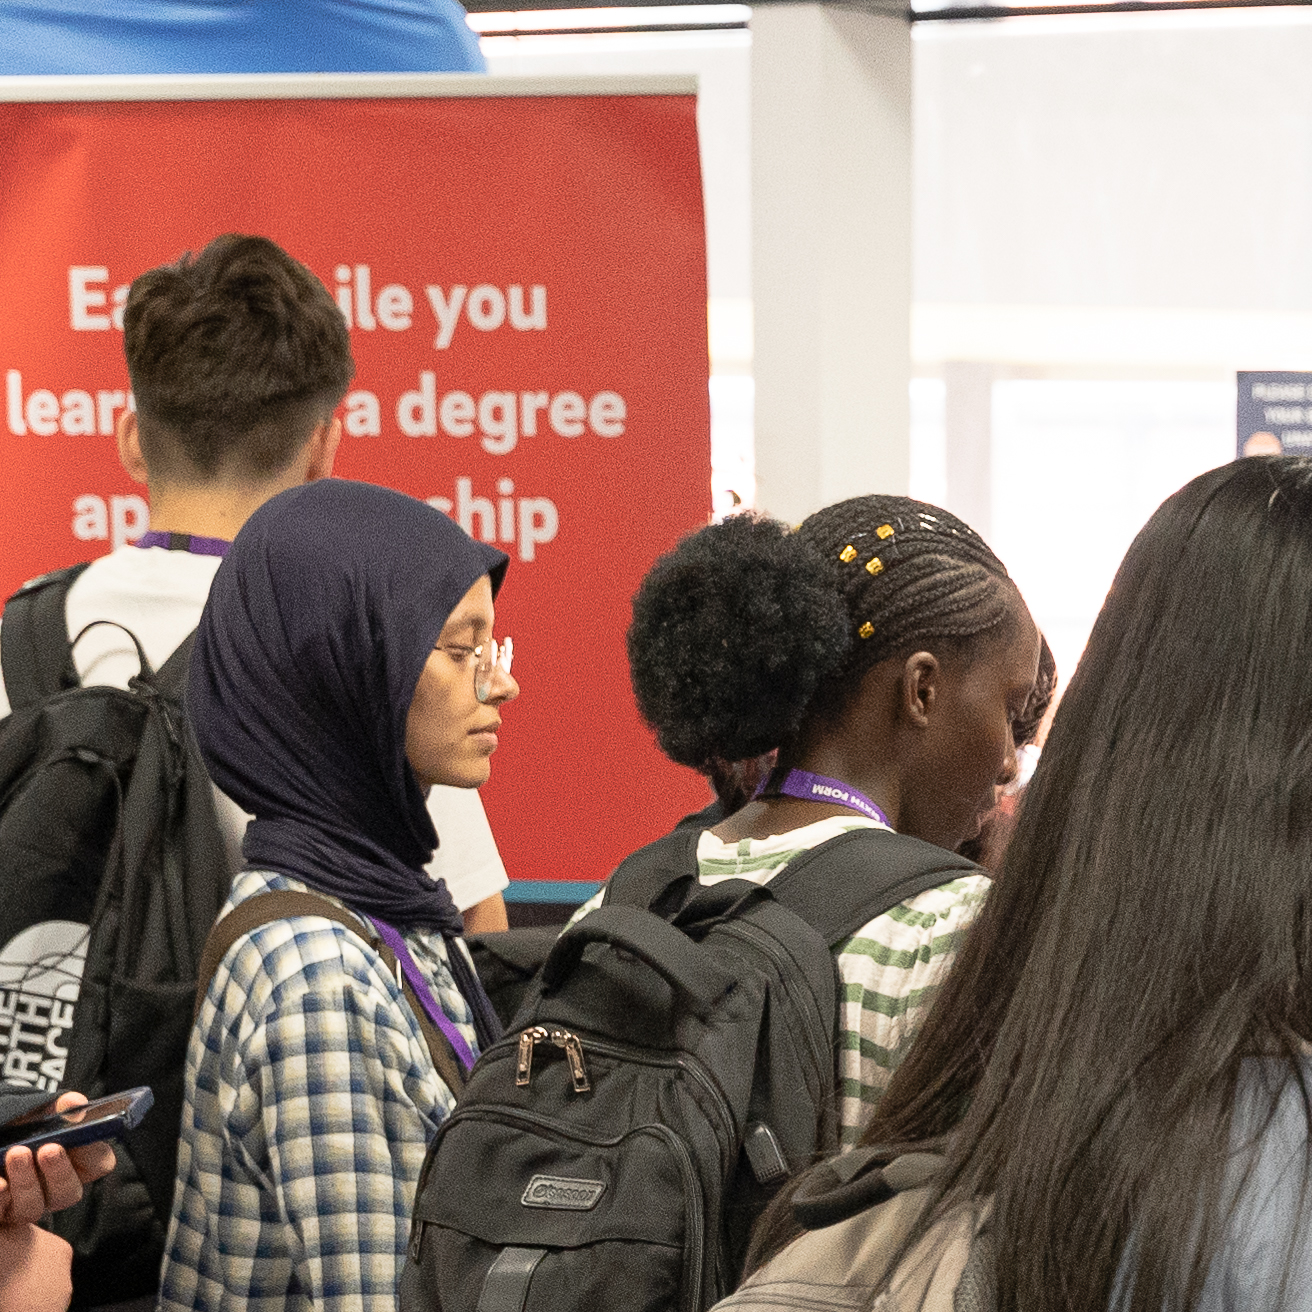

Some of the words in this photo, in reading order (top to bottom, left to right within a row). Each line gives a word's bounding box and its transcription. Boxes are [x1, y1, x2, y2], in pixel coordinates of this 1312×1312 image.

[336, 265, 414, 332] ile
[428, 283, 547, 350] you
[6, 371, 135, 436] lear
[346, 390, 381, 436] a
[398, 371, 627, 455] degree
[812, 784, 849, 801] FORM
